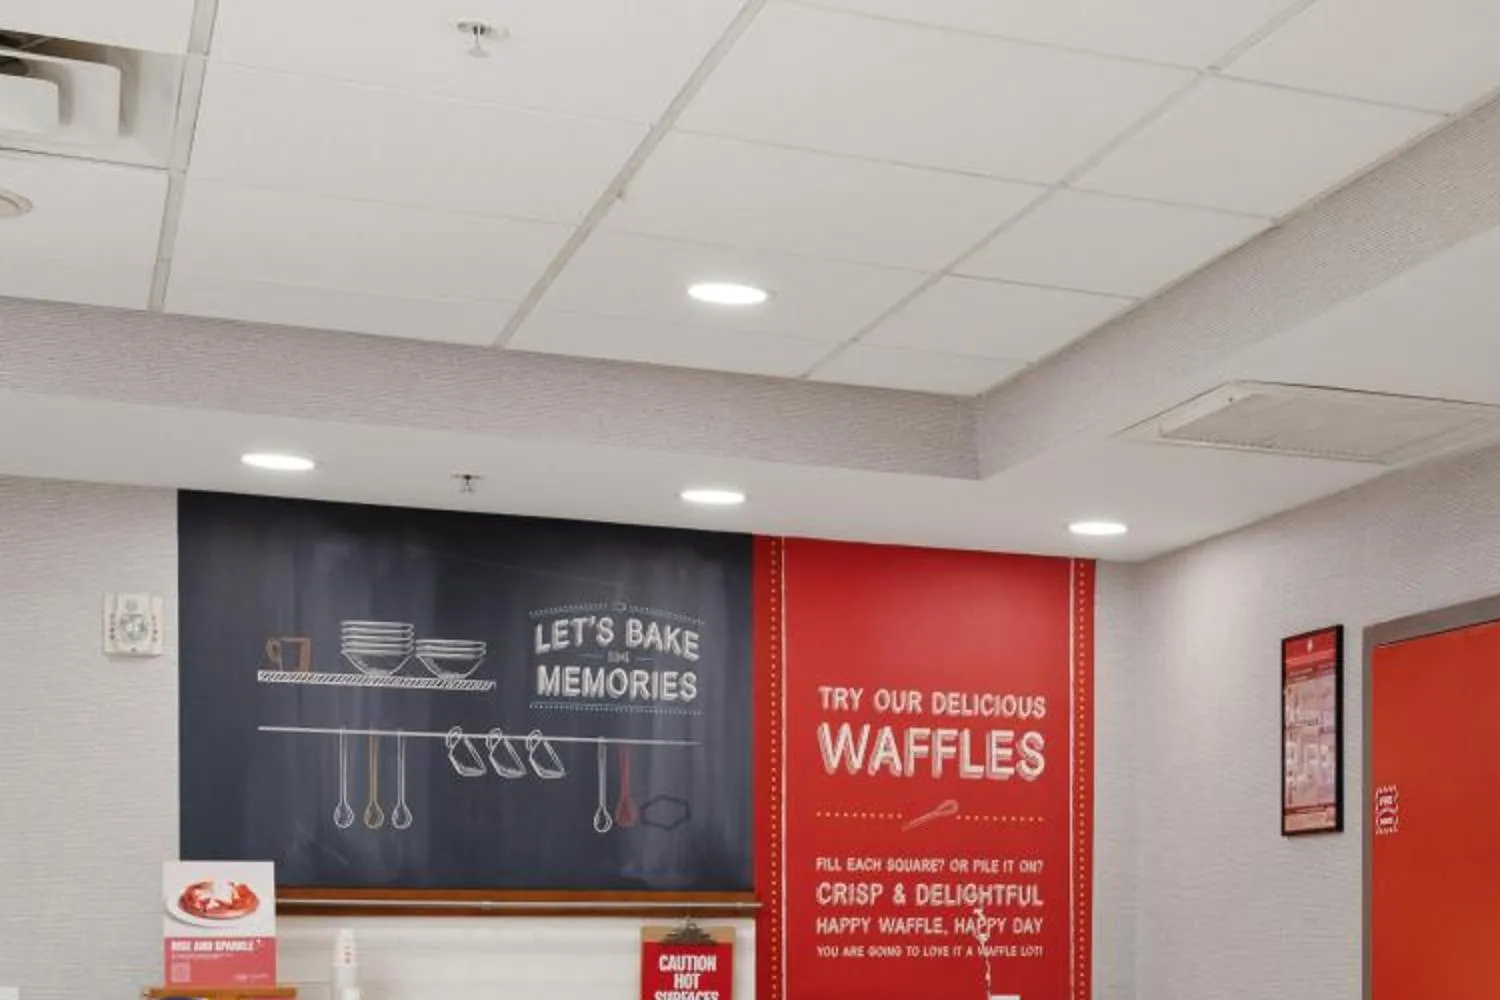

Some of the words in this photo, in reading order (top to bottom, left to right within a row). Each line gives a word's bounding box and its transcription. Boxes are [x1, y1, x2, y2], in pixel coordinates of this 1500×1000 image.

[535, 615, 614, 655] LET'S
[625, 617, 699, 663] BAKE
[536, 664, 697, 702] MEMORIES
[818, 685, 864, 711] TRY
[874, 688, 922, 714] OUR
[931, 691, 1046, 719] DELICIOUS
[817, 721, 1046, 782] WAFFLES
[816, 857, 841, 872] FILL
[847, 857, 881, 872] EACH
[887, 858, 944, 873] SQUARE?
[949, 858, 969, 873] OR
[973, 858, 999, 873] PILE
[1003, 859, 1015, 873] IT
[816, 881, 883, 906] CRISP
[893, 882, 907, 906] &
[915, 883, 1044, 907] DELIGHTFUL
[816, 916, 870, 935] HAPPY
[954, 916, 1007, 936] HAPPY
[1013, 917, 1043, 935] DAY
[817, 945, 839, 957] YOU
[842, 945, 865, 957] ARE
[906, 945, 920, 957] TO
[923, 945, 949, 957] LOVE
[953, 945, 962, 957] IT
[965, 945, 973, 957] A
[659, 954, 717, 972] CAUTION
[674, 973, 701, 990] HOT
